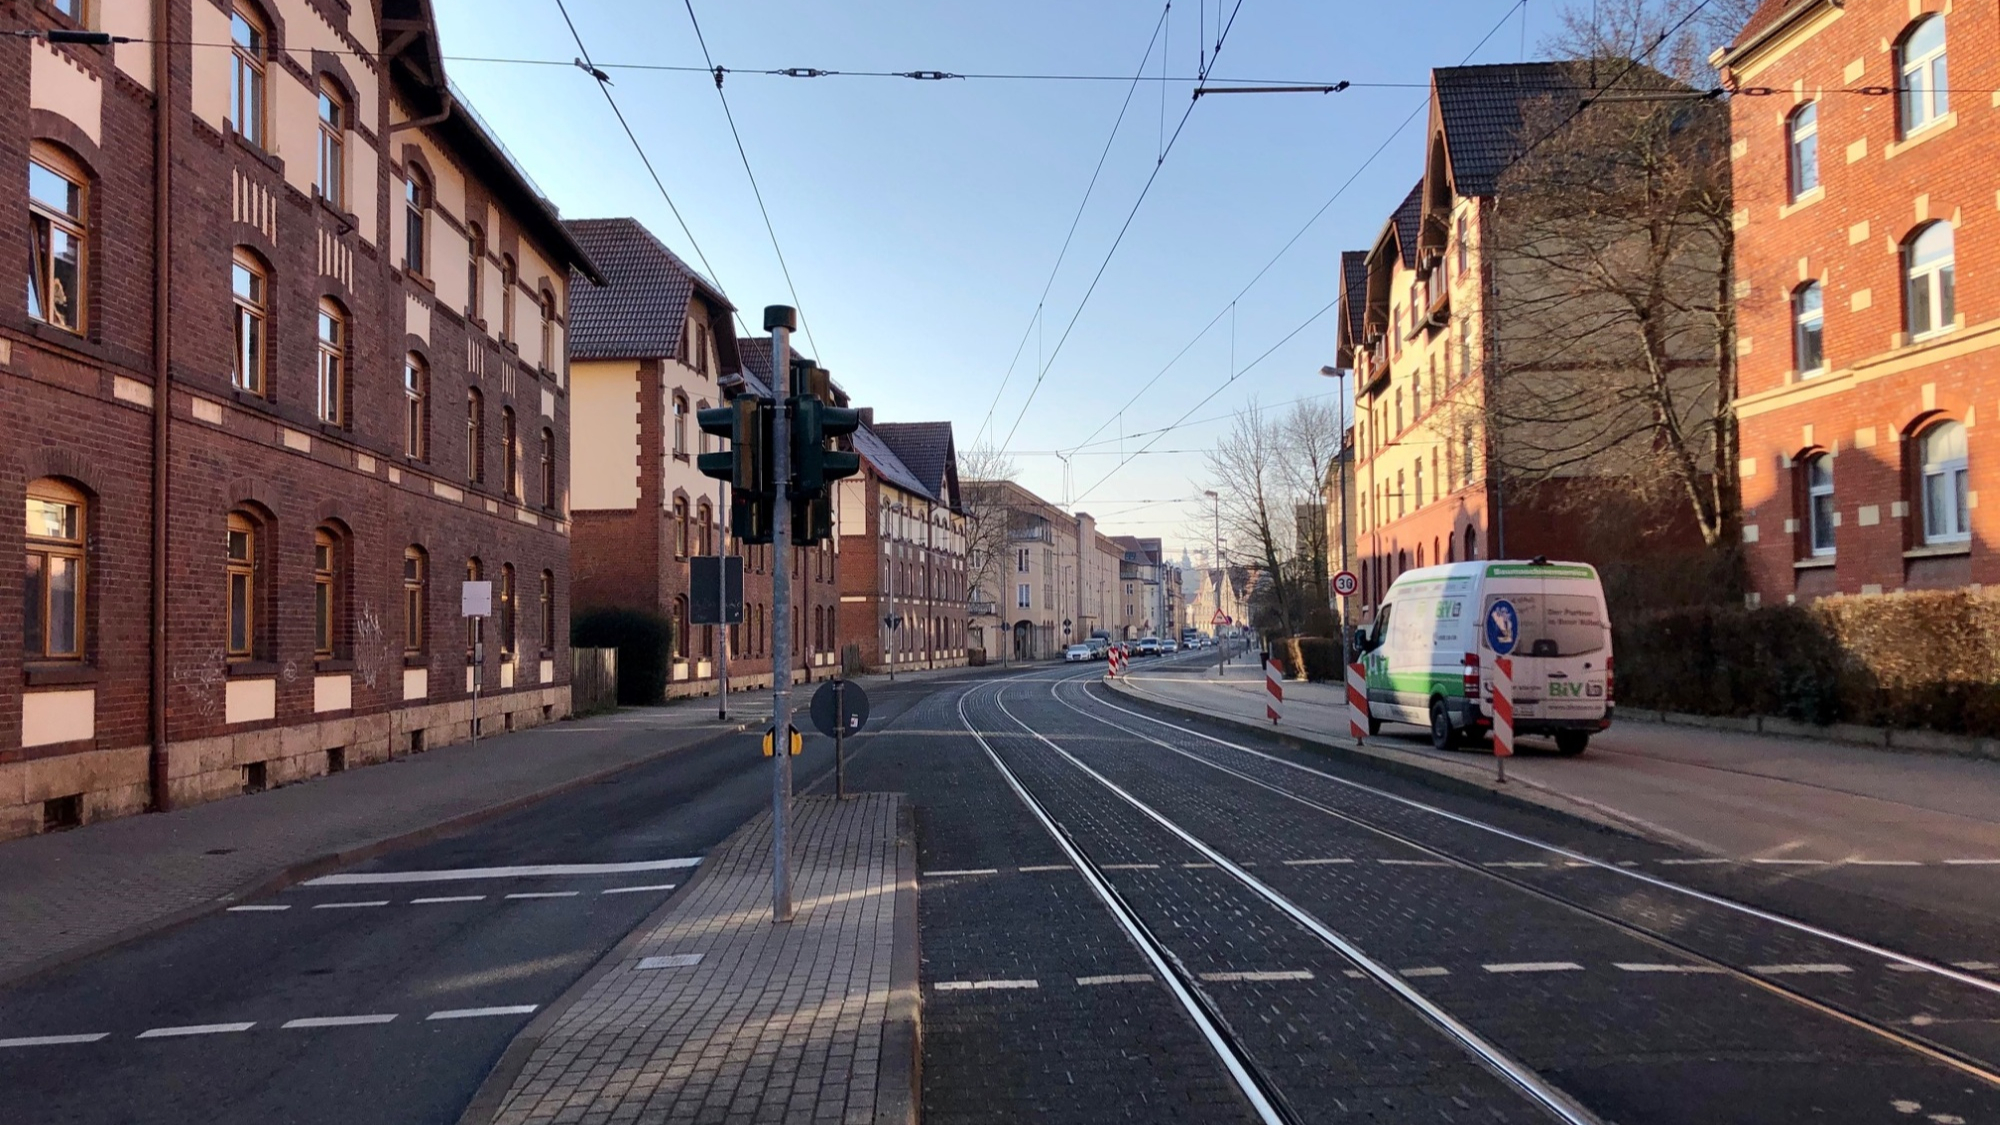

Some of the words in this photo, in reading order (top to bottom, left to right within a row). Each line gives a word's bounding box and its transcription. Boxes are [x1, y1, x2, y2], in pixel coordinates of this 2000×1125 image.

[1338, 578, 1353, 589] 30
[1564, 608, 1594, 616] Partner
[1549, 682, 1583, 696] BiV
